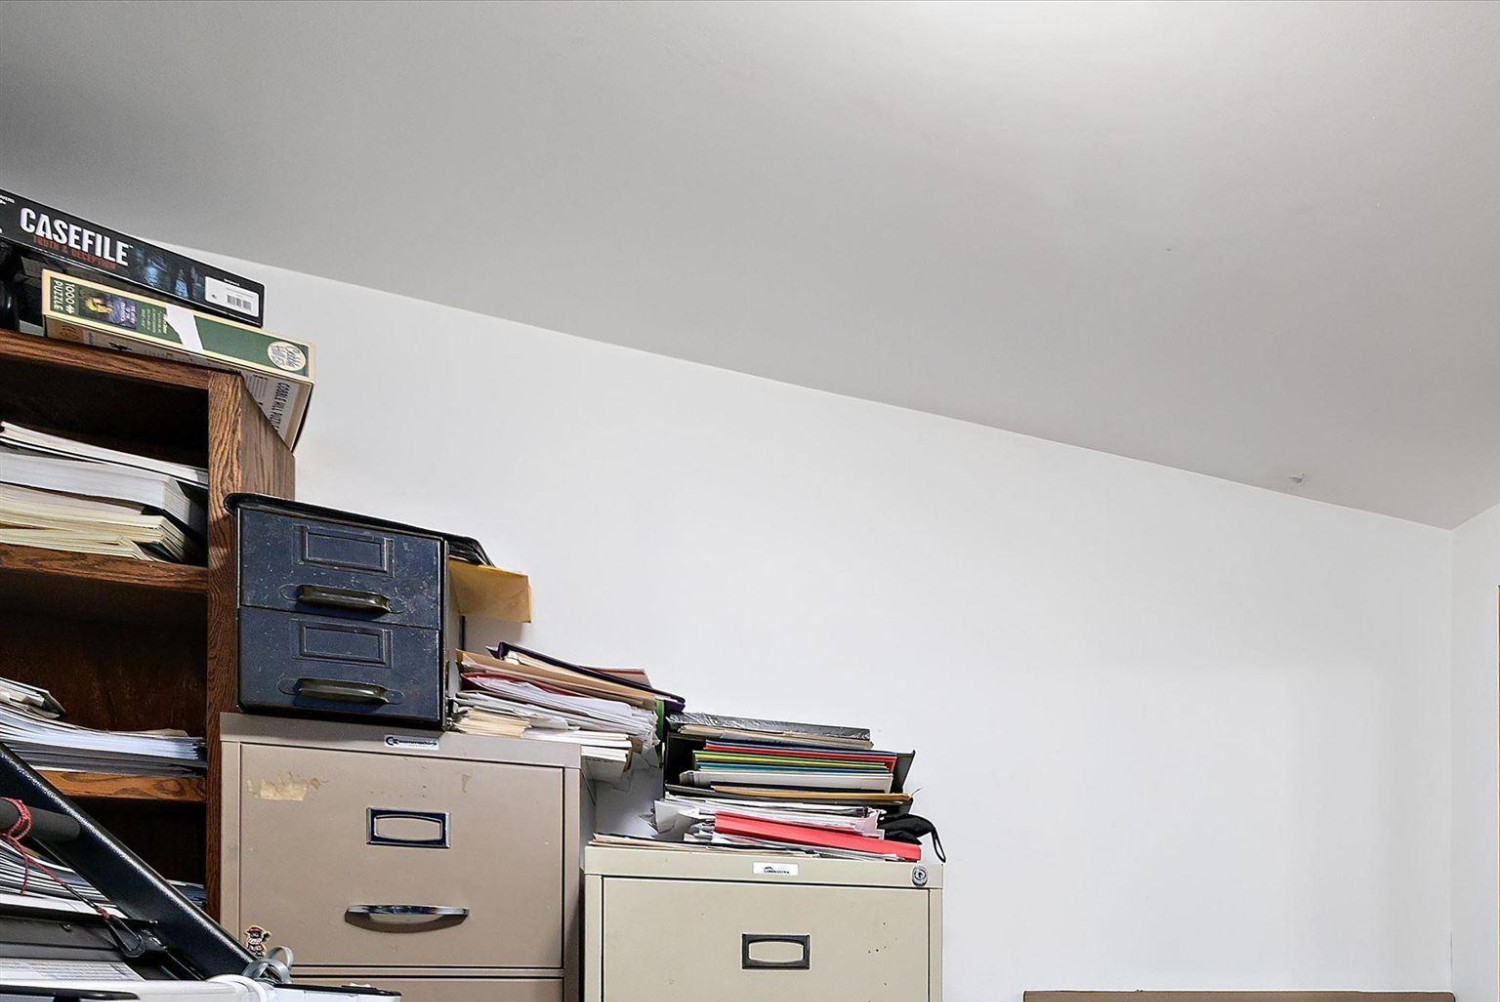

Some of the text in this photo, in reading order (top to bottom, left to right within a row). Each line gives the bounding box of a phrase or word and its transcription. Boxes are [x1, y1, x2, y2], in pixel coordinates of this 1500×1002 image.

[20, 207, 129, 267] CASEFILE
[54, 280, 64, 311] PUZZLE
[65, 283, 75, 305] 1000
